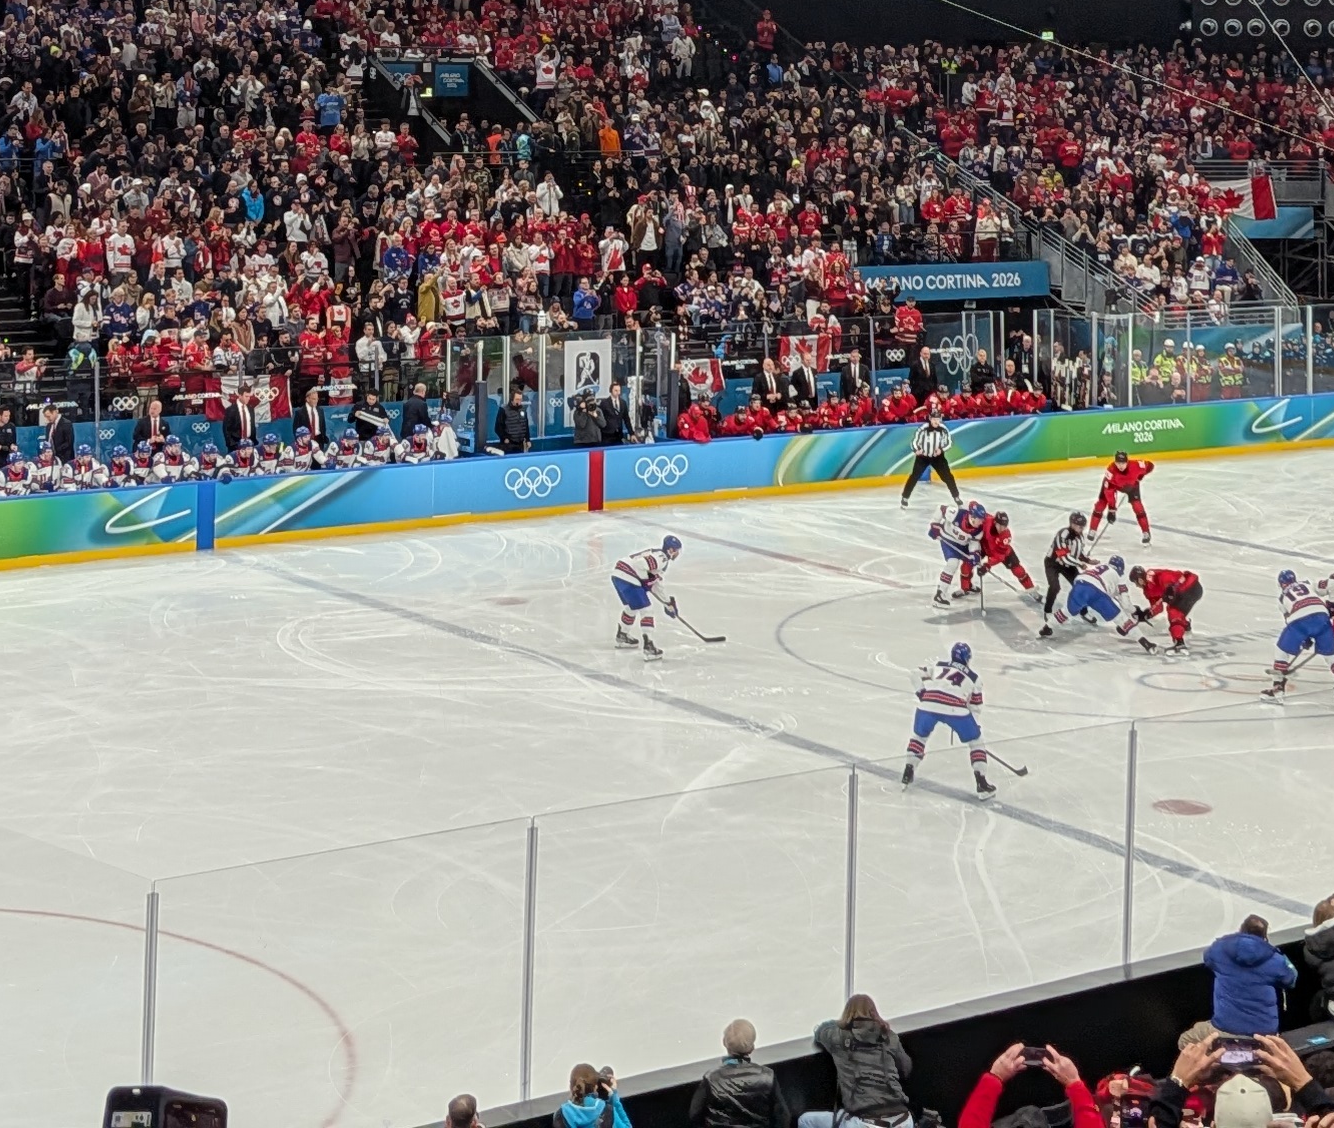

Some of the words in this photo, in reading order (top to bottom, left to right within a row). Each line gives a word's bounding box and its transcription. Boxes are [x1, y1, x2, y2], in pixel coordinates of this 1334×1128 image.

[865, 274, 923, 291] MANO
[926, 274, 990, 290] CORTINA
[991, 272, 1021, 287] 2026
[1101, 421, 1143, 435] MILANO
[1143, 418, 1185, 432] CORTINA
[1133, 432, 1154, 443] 2026
[1284, 583, 1310, 602] 19
